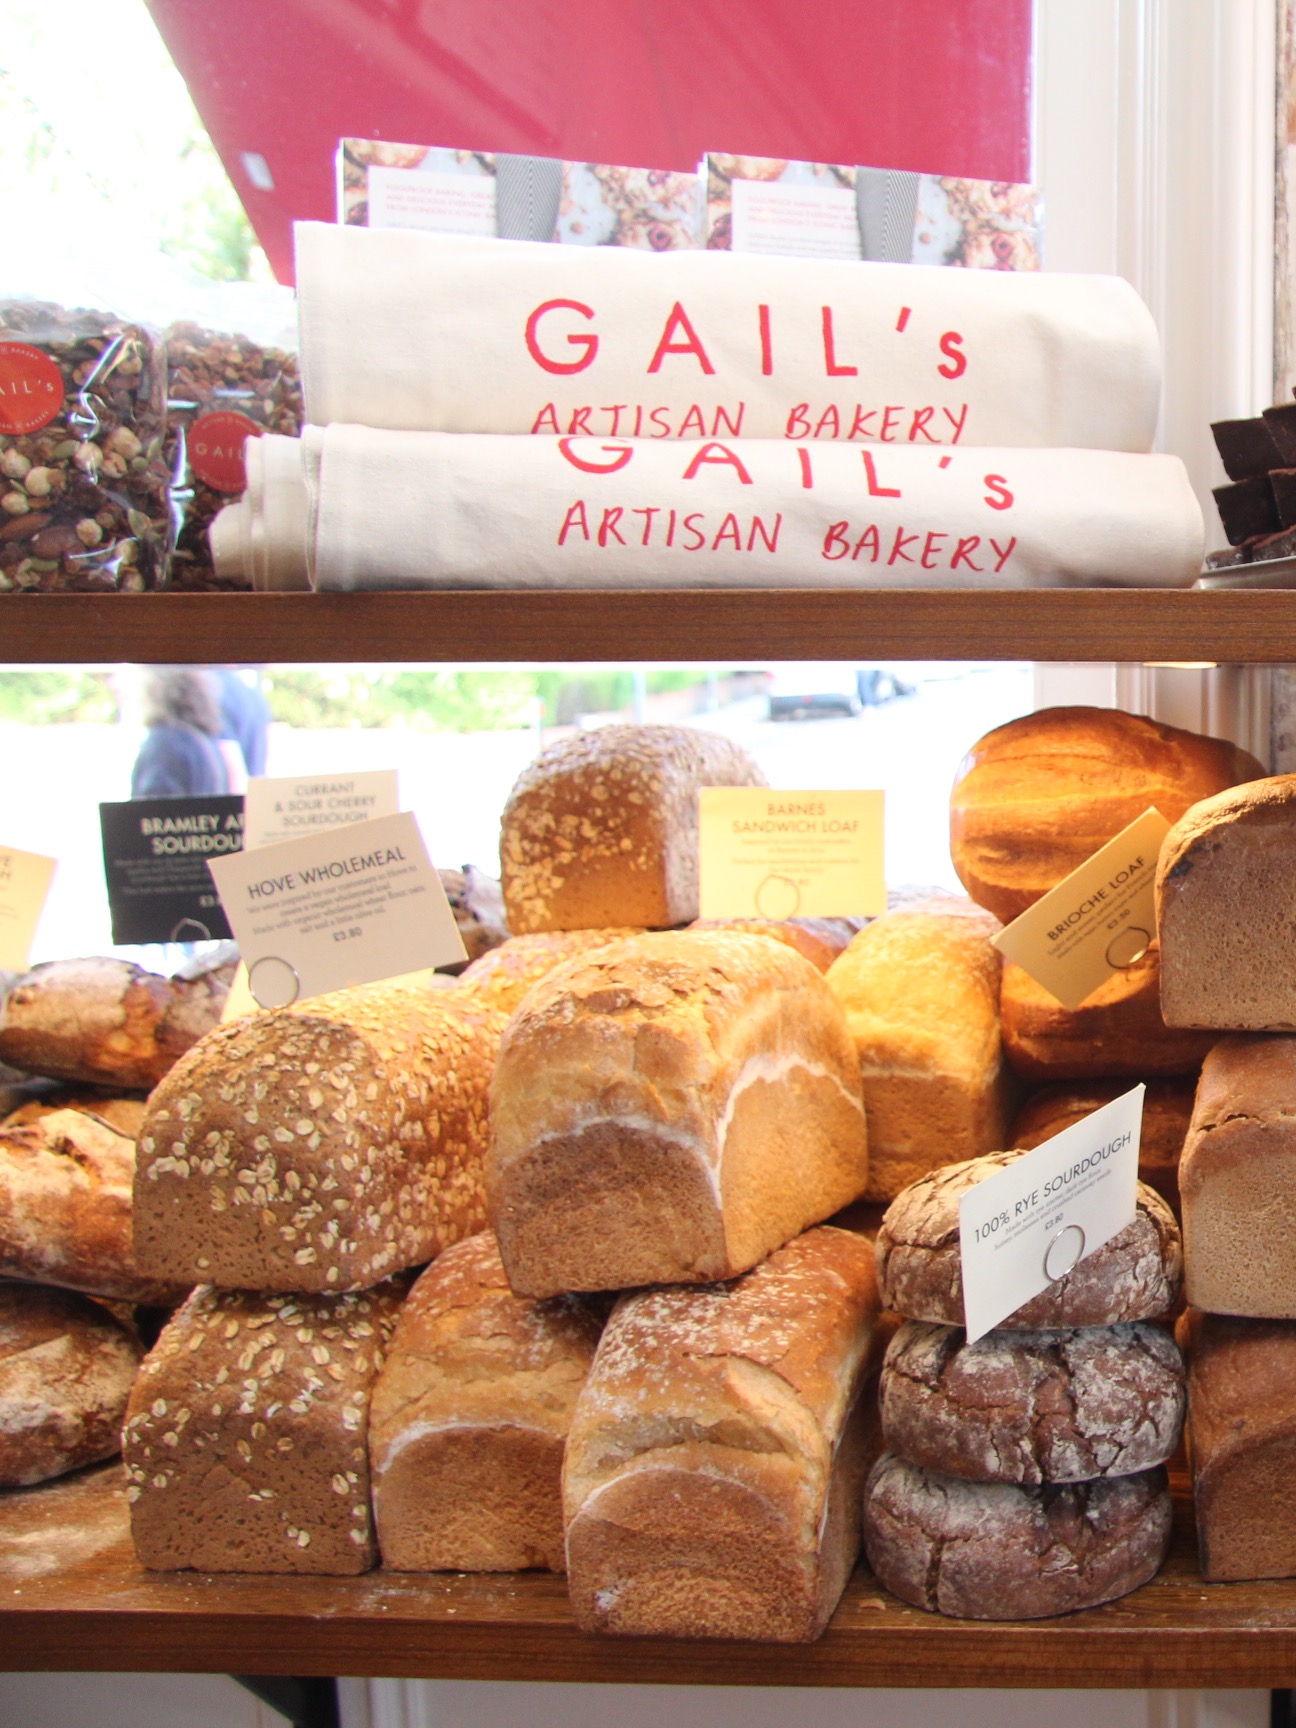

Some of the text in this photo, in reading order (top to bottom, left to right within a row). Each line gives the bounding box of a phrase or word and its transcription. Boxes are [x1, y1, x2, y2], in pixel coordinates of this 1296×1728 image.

[525, 298, 967, 379] GAIL's
[530, 402, 968, 444] ARTISAN BAKERY
[558, 437, 1015, 510] GAIL's
[557, 500, 1017, 573] ARTISAN BAKERY
[141, 814, 220, 836] BRAMLEY
[282, 811, 368, 826] SOURDOUGH
[732, 820, 860, 833] SANDWICH LOAF
[766, 803, 826, 816] BARNES
[152, 833, 242, 855] SOURDOU
[247, 846, 405, 900] HOVE WHOLEMEAL
[1047, 856, 1145, 941] BRIOCHE LOAF
[974, 1130, 1133, 1243] 100% RYE SOURDOUGH
